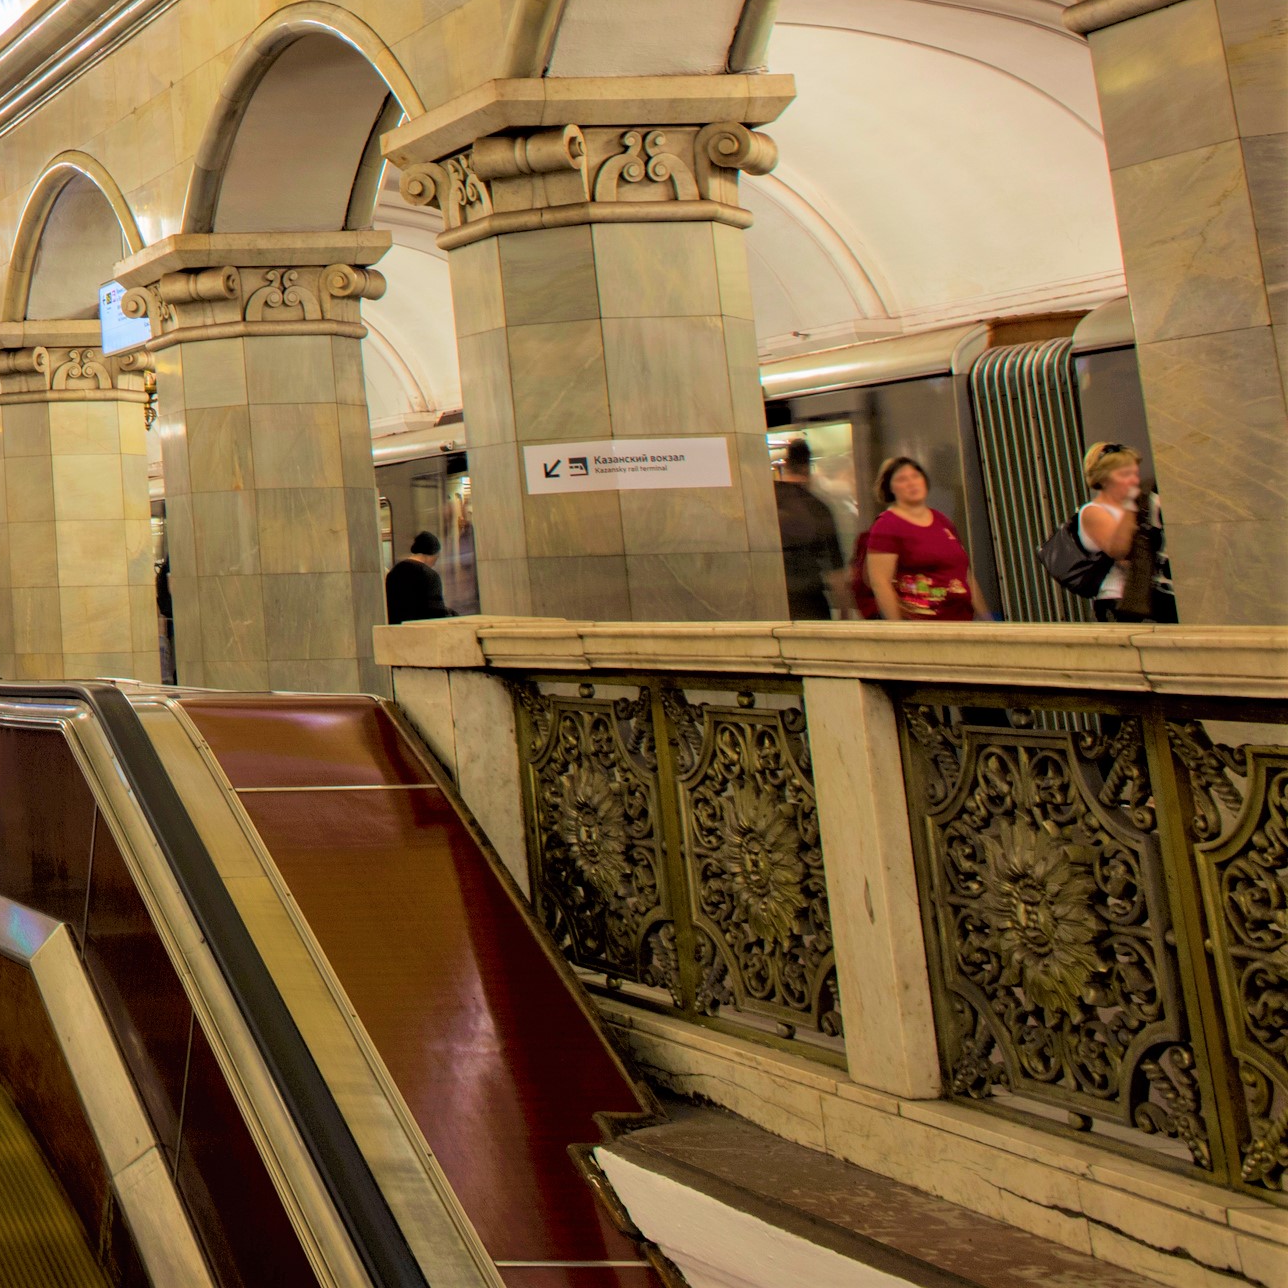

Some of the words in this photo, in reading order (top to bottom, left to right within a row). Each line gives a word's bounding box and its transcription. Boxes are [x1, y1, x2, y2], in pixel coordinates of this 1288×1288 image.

[594, 454, 648, 465] Казанский
[650, 454, 685, 463] вокзал
[595, 466, 626, 474] Kazansky
